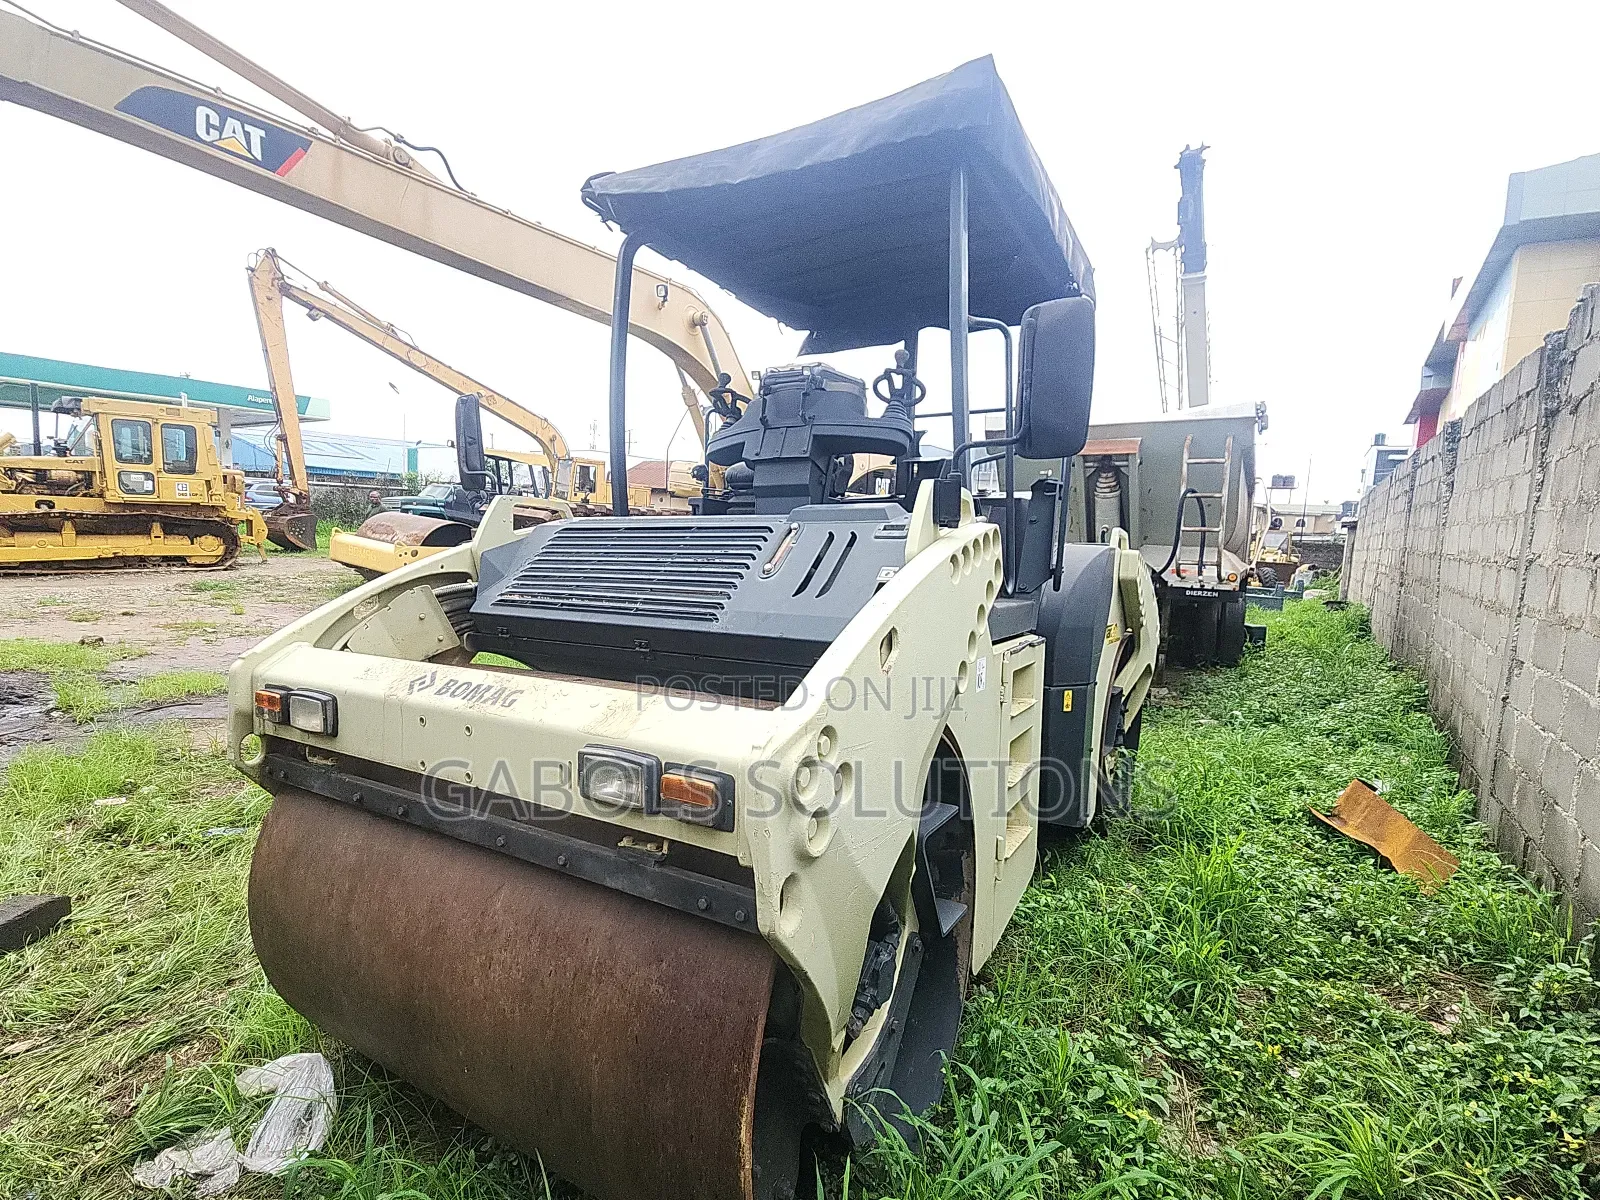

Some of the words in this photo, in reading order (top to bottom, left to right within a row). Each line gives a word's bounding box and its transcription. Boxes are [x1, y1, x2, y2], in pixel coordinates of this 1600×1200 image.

[195, 105, 267, 162] CAT
[875, 477, 891, 495] CAT
[1185, 589, 1219, 598] DIERZEN
[434, 678, 525, 708] BOMAG
